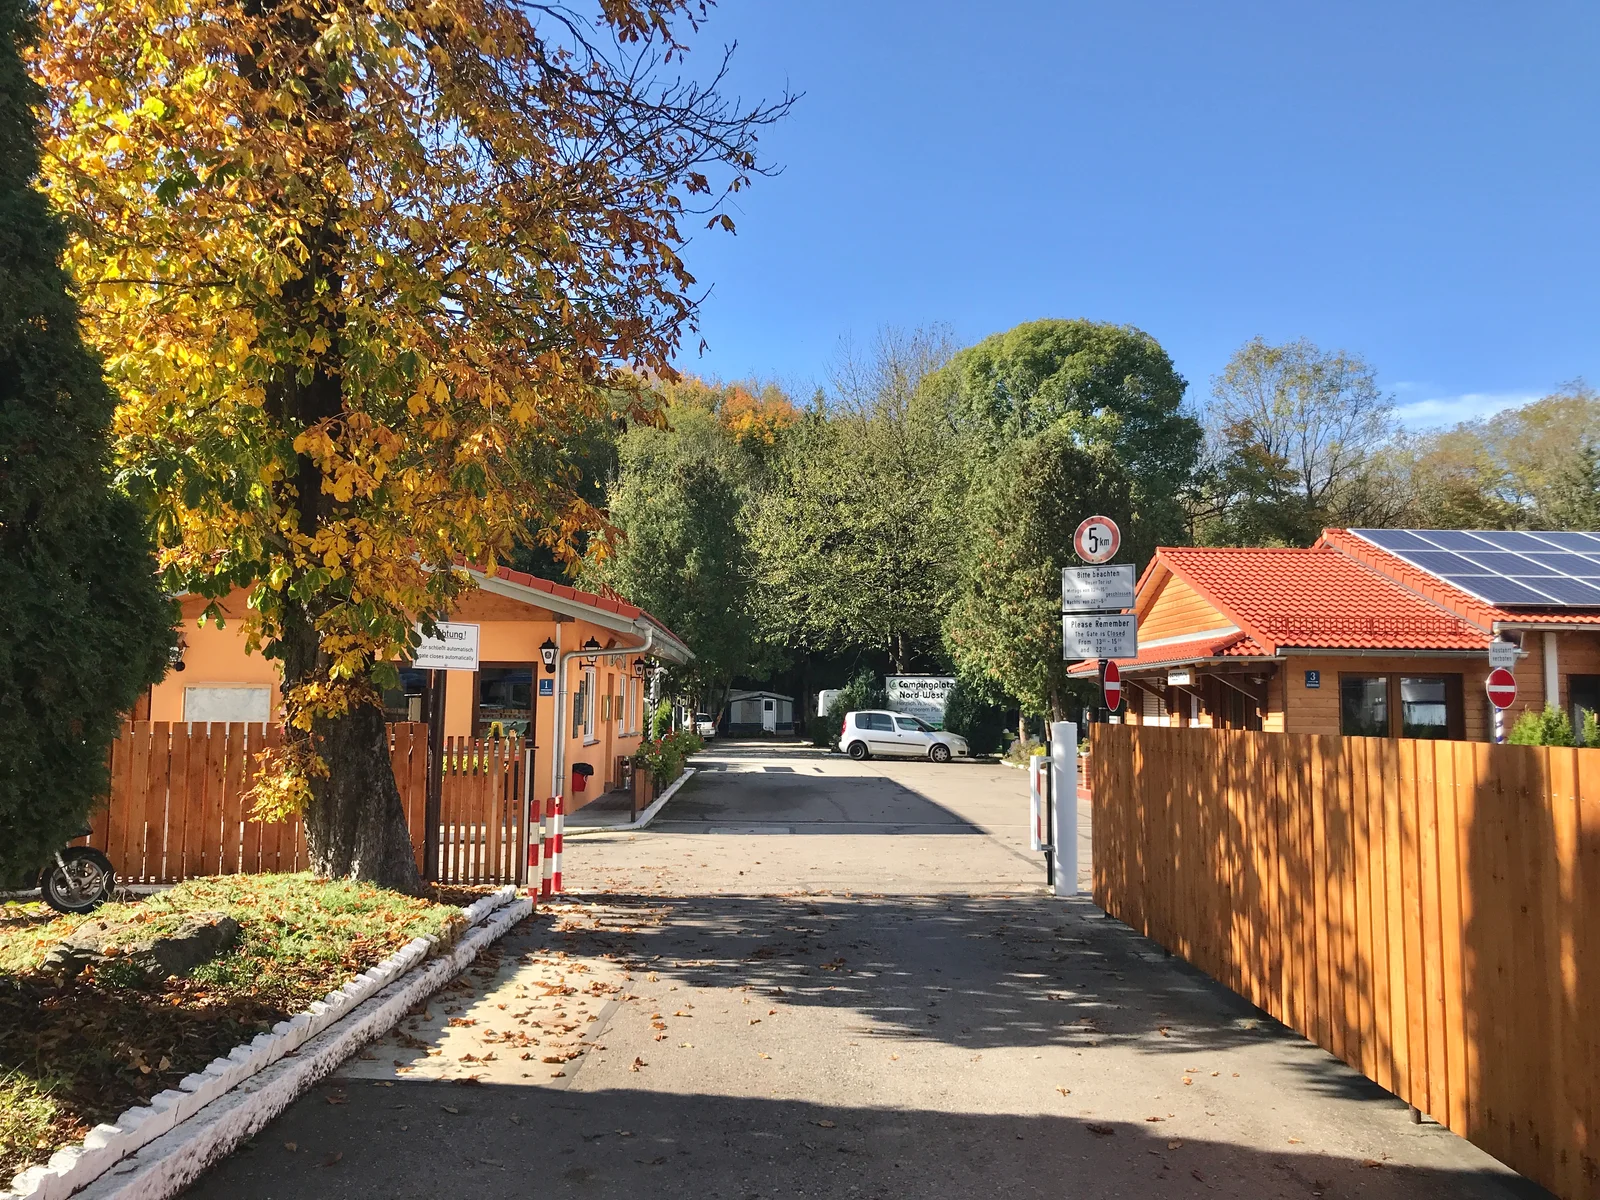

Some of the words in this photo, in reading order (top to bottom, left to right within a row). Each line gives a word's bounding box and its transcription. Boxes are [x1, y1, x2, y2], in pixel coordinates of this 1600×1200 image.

[1088, 527, 1099, 553] 5
[1099, 537, 1110, 546] km
[1310, 671, 1316, 681] 3
[544, 680, 549, 689] 1
[898, 680, 954, 690] Campingplatz
[899, 690, 944, 699] Nord-West
